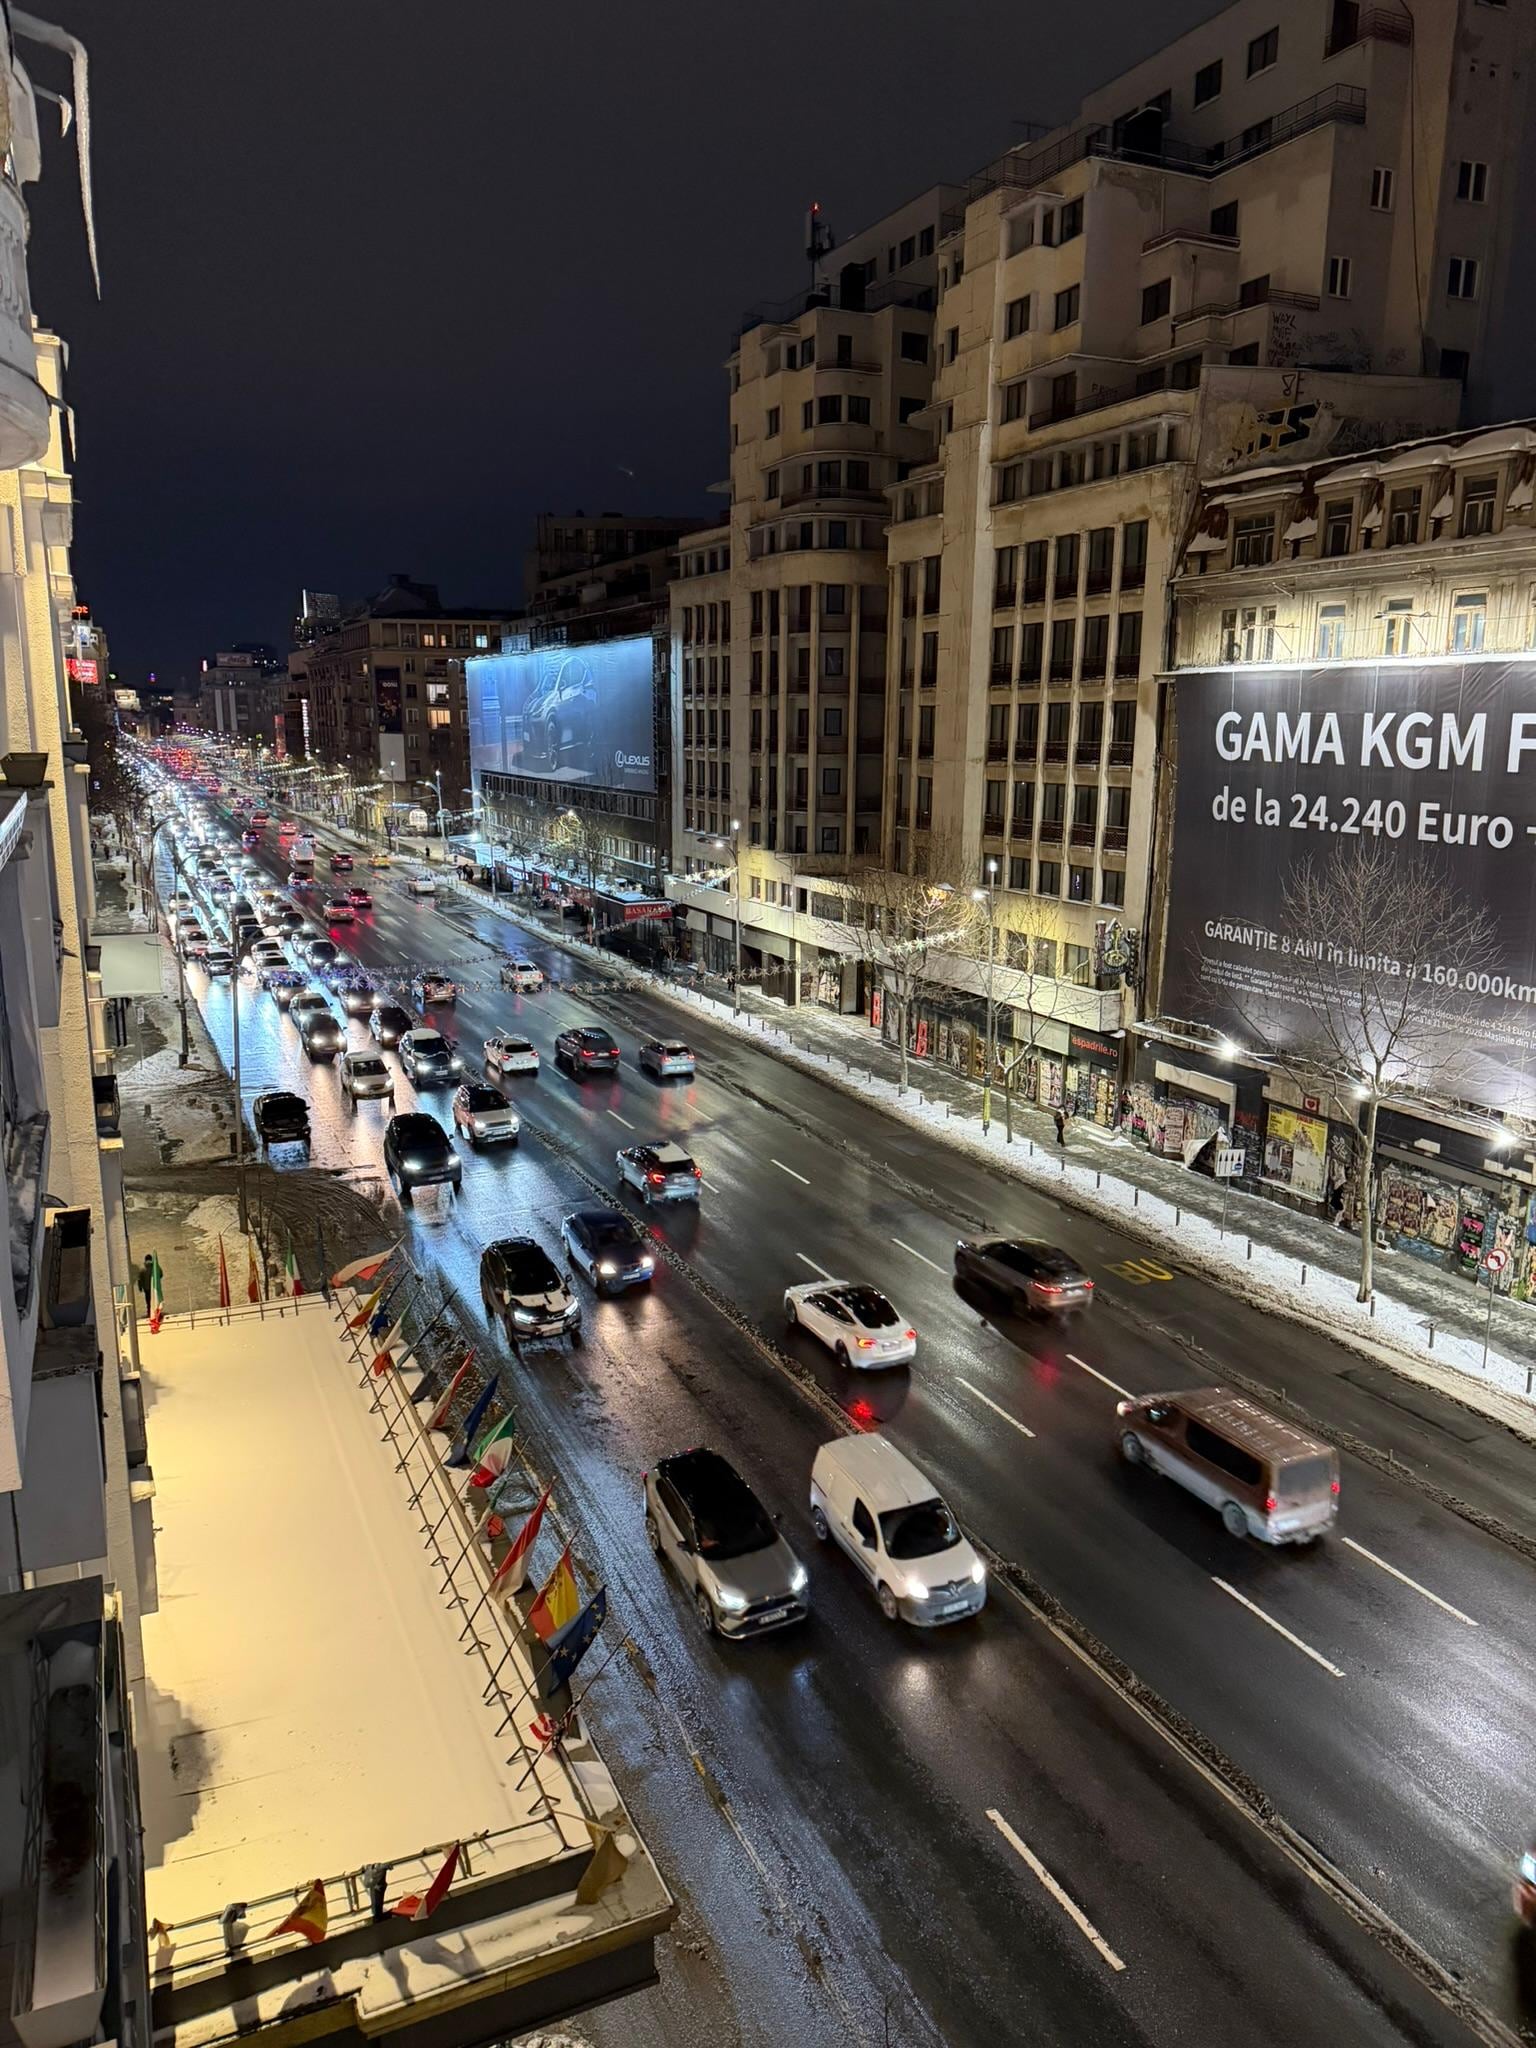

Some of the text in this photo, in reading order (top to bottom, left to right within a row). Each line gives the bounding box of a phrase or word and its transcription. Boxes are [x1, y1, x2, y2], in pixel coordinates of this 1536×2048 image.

[624, 754, 650, 766] LEXUS
[1215, 711, 1346, 766] GAMA
[1360, 711, 1488, 772] KGM
[1212, 785, 1247, 823] de
[1255, 787, 1281, 826] la
[1289, 793, 1406, 839] 24.240
[1417, 802, 1514, 849] Euro
[1294, 938, 1323, 961] ANI
[1422, 963, 1536, 1004] 160.000km
[1071, 1035, 1118, 1058] espadrile.ro
